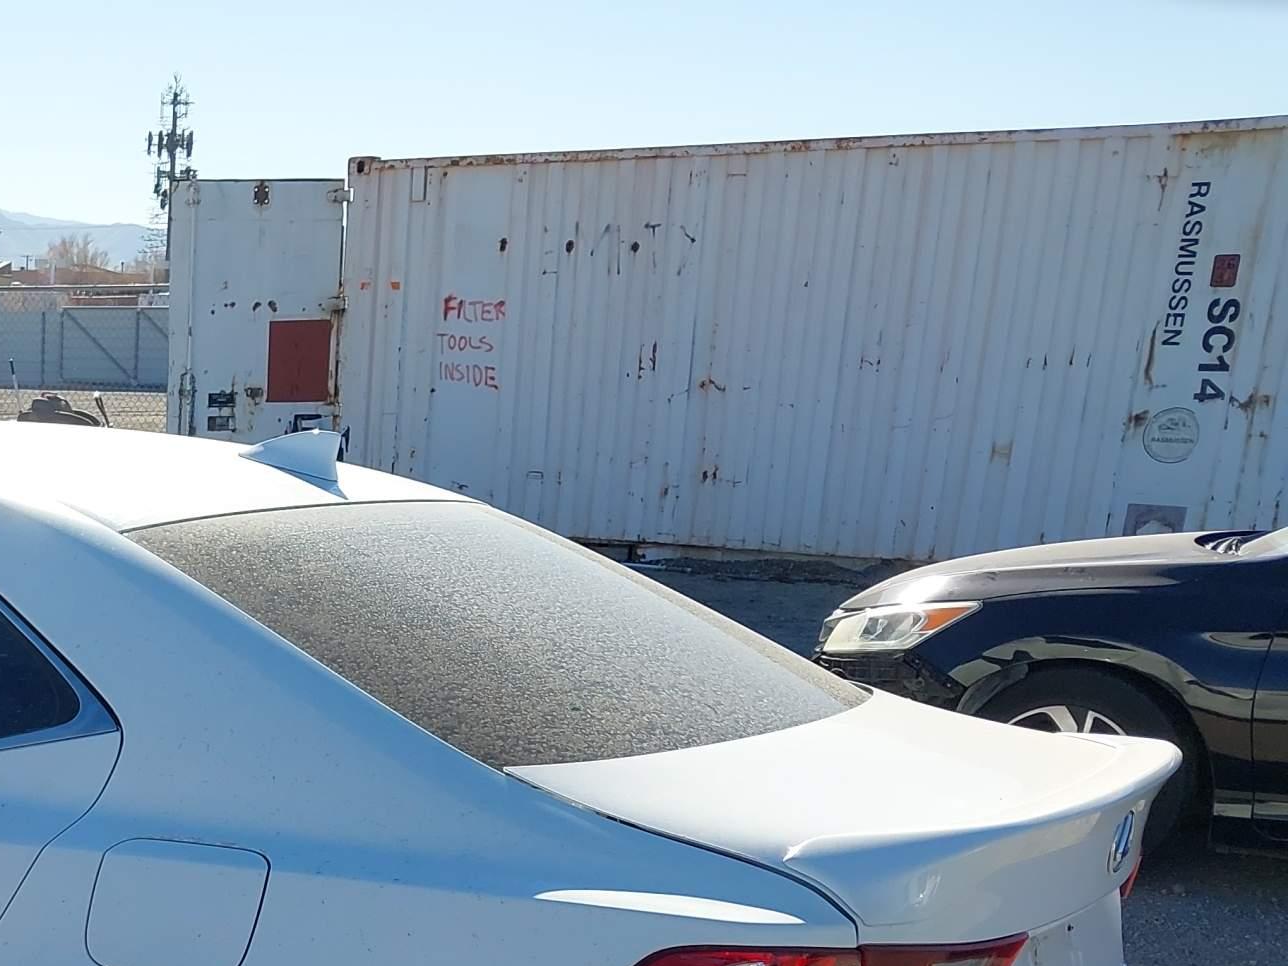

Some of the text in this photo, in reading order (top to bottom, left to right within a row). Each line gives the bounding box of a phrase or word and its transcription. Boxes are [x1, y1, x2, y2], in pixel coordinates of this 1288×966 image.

[1162, 181, 1211, 346] RASMUSSEN
[442, 296, 506, 322] FILTER
[436, 333, 494, 354] TOOLS
[1193, 297, 1241, 403] SC14
[439, 361, 499, 390] INSIDE
